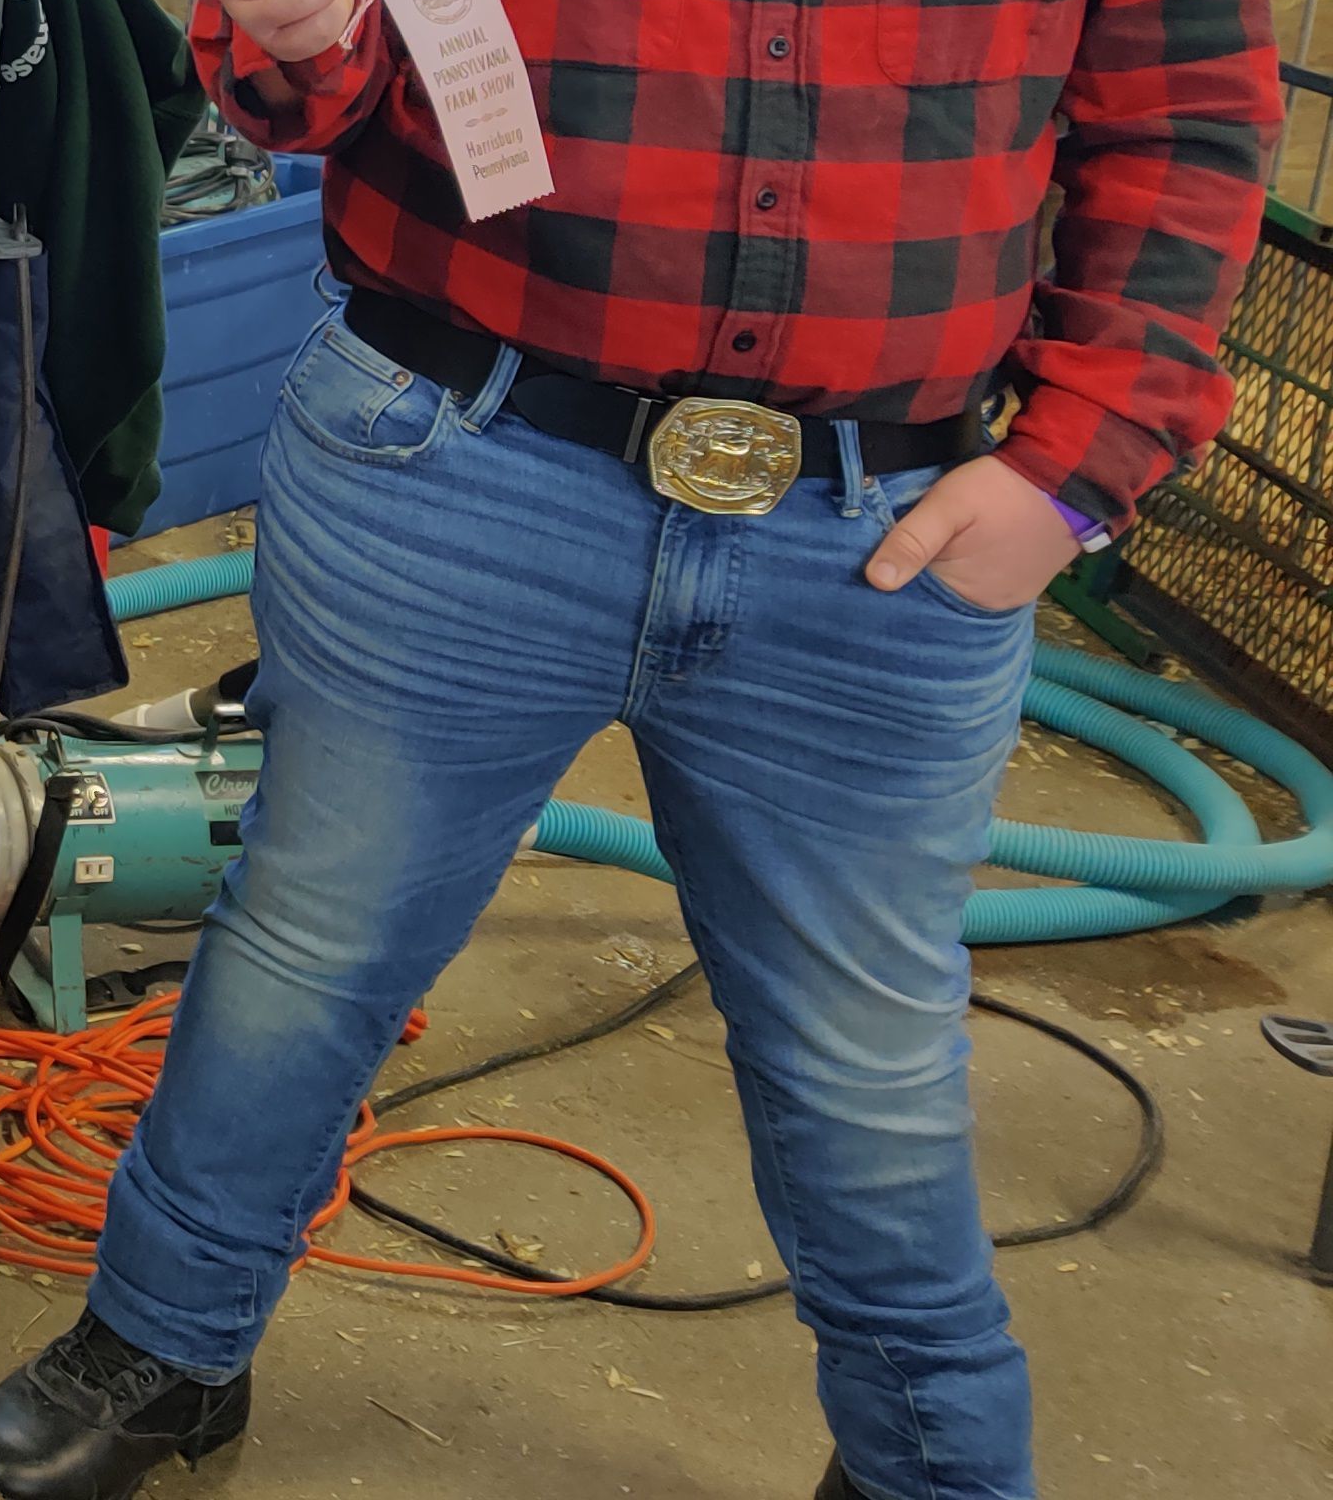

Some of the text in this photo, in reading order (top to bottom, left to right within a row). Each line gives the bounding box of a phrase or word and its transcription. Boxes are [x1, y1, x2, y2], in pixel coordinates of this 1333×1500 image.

[439, 26, 489, 58] ANNUAL
[433, 47, 511, 88] PENNSYLVANIA
[444, 72, 516, 112] FARM SHOW
[466, 128, 523, 158] Harrisburg
[472, 150, 530, 180] Pennsylvania
